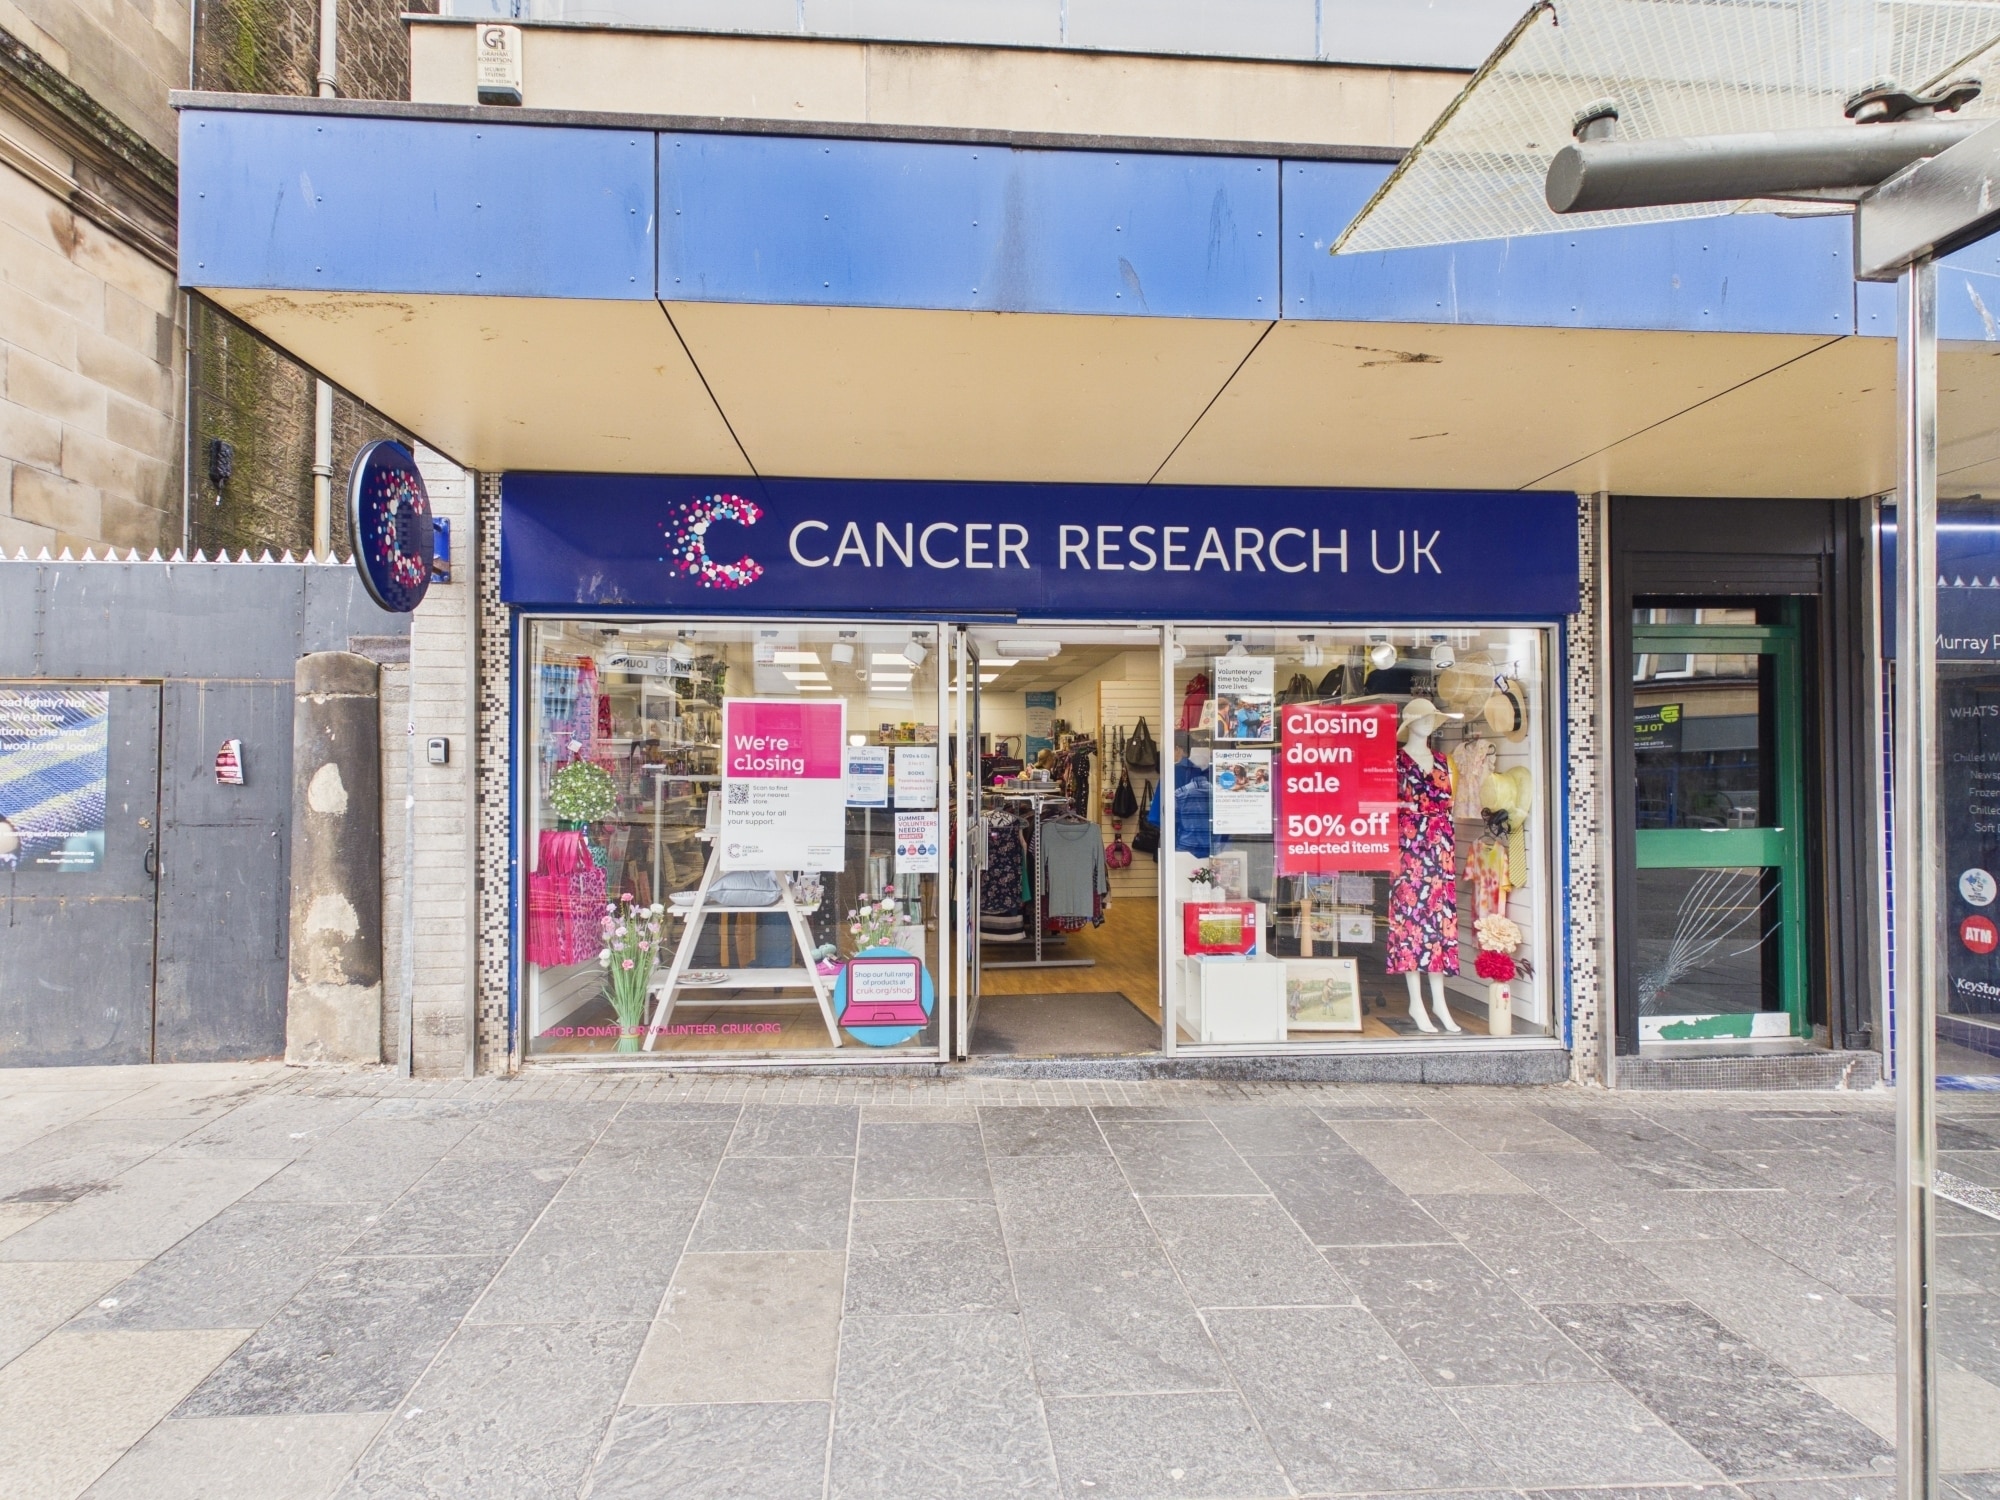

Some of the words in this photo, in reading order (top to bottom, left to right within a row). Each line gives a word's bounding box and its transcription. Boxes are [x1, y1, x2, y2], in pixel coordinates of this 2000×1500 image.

[789, 520, 1030, 570] CANCER
[1058, 524, 1348, 573] RESEARCH
[1372, 529, 1442, 574] UK
[24, 696, 64, 709] lightly?
[66, 698, 86, 708] Not
[12, 712, 30, 721] We
[32, 712, 64, 721] throw
[1950, 705, 1999, 718] WHAT'S
[40, 728, 58, 736] the
[60, 727, 86, 736] wind
[1287, 713, 1378, 738] Closing
[3, 741, 30, 750] wool
[32, 742, 44, 750] to
[46, 742, 64, 751] the
[67, 741, 98, 751] loom!
[734, 735, 788, 751] We're
[1287, 743, 1352, 763] down
[1953, 752, 1985, 762] Chilled
[734, 754, 804, 774] closing
[1287, 772, 1340, 793] sale
[752, 811, 765, 820] you
[1288, 814, 1346, 837] 50%
[1350, 812, 1390, 836] off
[1288, 841, 1349, 854] selected
[1352, 841, 1390, 853] items
[1965, 926, 1992, 944] ATM
[856, 987, 912, 995] cruk.org/shop
[577, 1026, 623, 1037] DONATE
[649, 1024, 718, 1036] VOLUNTEER.
[721, 1023, 780, 1034] CRUK.ORG
